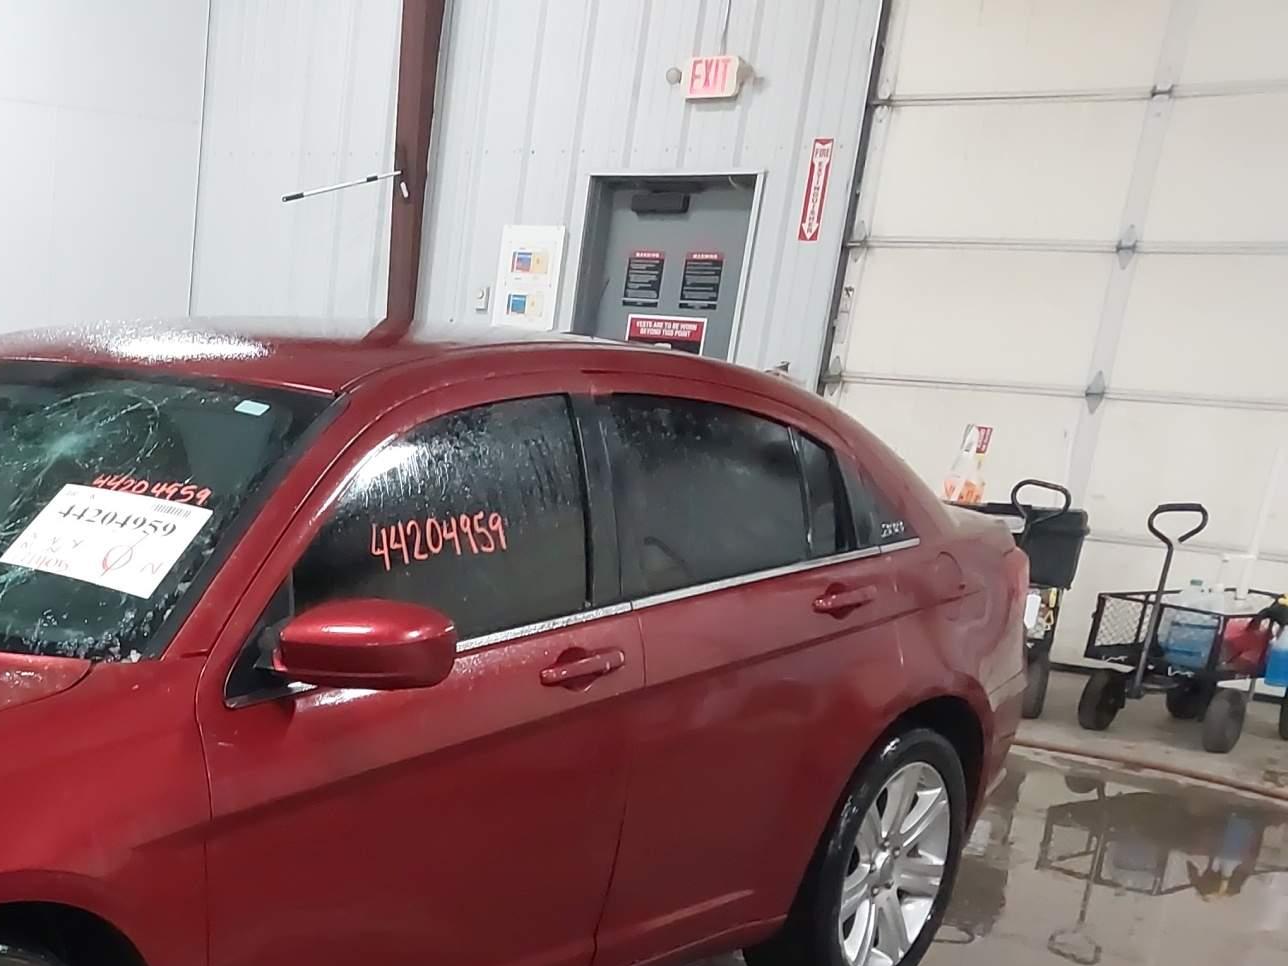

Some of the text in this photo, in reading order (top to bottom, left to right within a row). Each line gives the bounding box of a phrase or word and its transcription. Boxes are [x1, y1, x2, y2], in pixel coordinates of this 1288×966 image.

[689, 59, 731, 95] EXIT
[92, 473, 212, 506] 44204959
[59, 503, 177, 538] 44204959
[370, 511, 509, 572] 44204959
